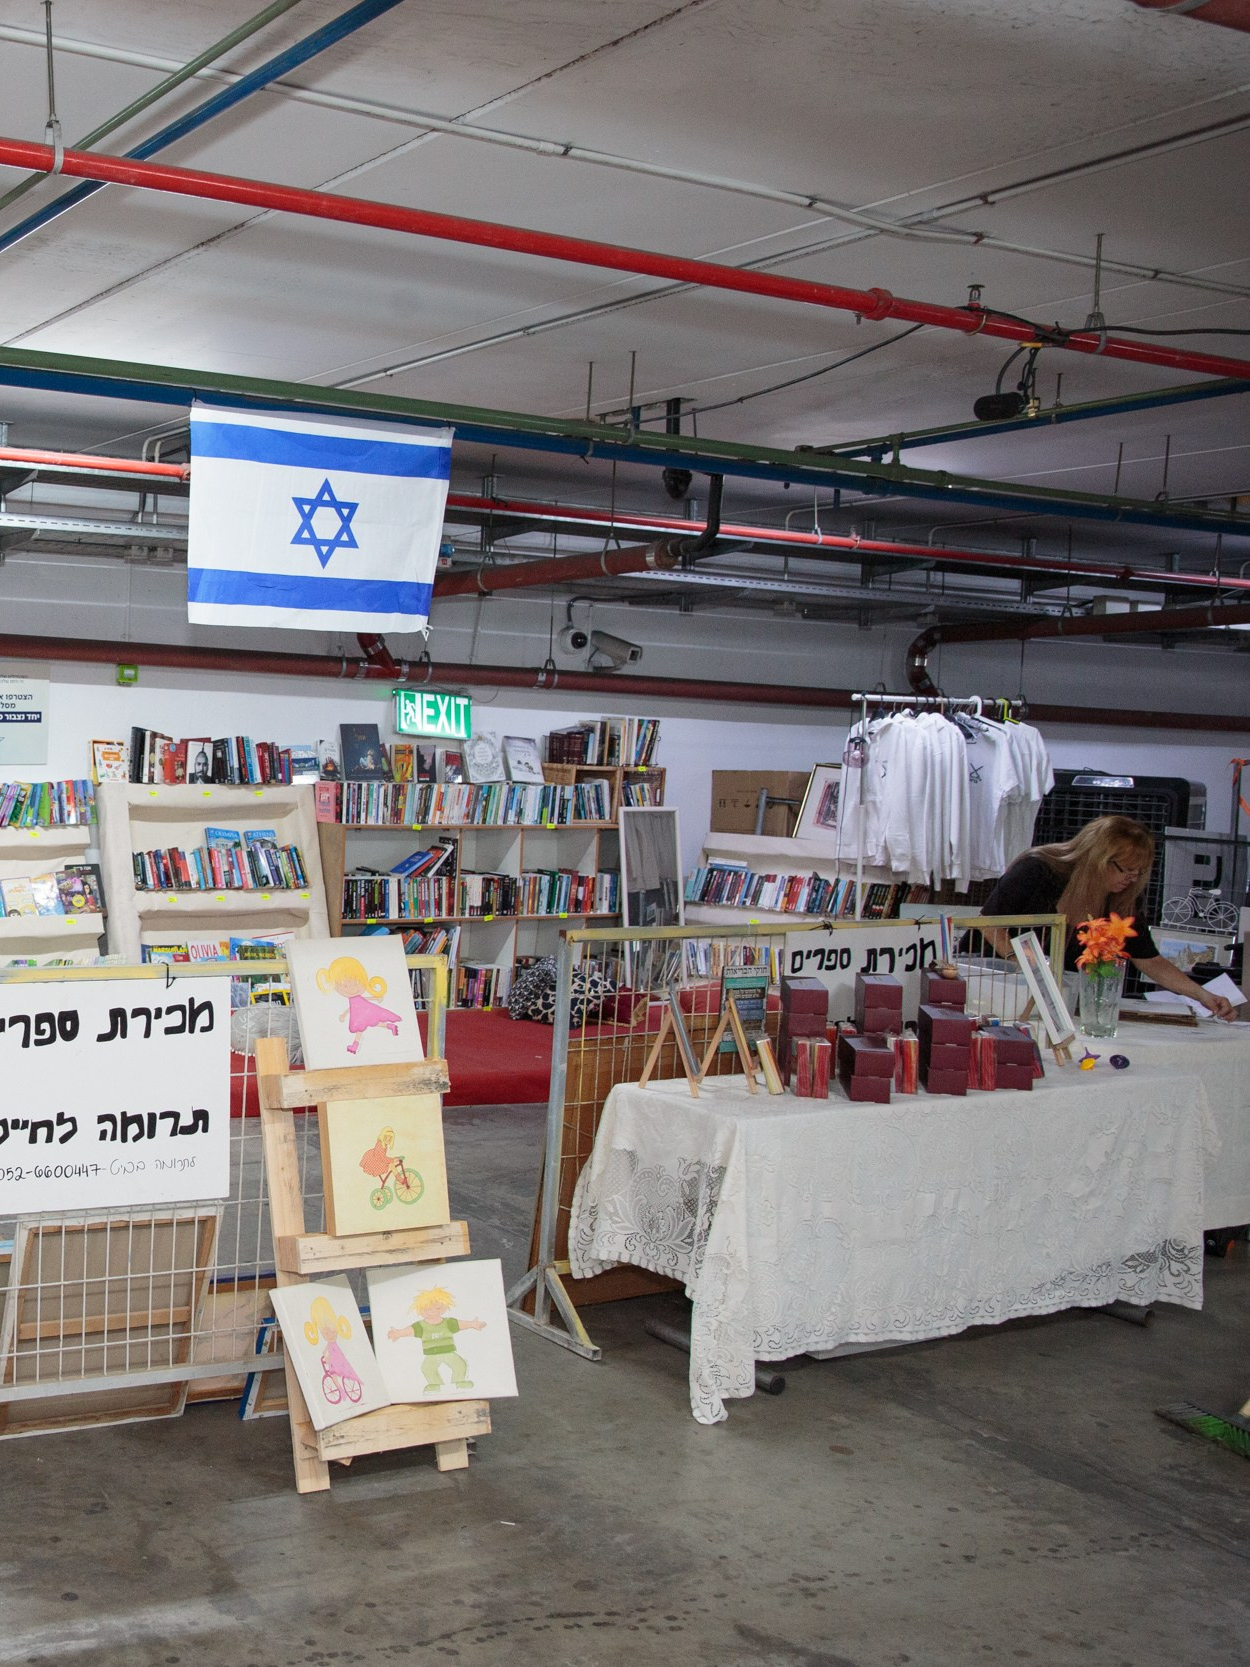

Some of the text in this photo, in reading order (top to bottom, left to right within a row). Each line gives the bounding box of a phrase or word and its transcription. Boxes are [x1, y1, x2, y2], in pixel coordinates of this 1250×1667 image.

[0, 701, 16, 709] מסל
[6, 693, 33, 701] הצטרפו
[422, 693, 469, 737] EXIT
[190, 944, 219, 959] OLIVIA
[790, 937, 938, 974] מכירת ספרים
[726, 967, 768, 976] חוקי הבריאות
[96, 996, 215, 1043] מכירת
[96, 1106, 210, 1143] תרומה
[154, 1156, 197, 1172] לתרומה
